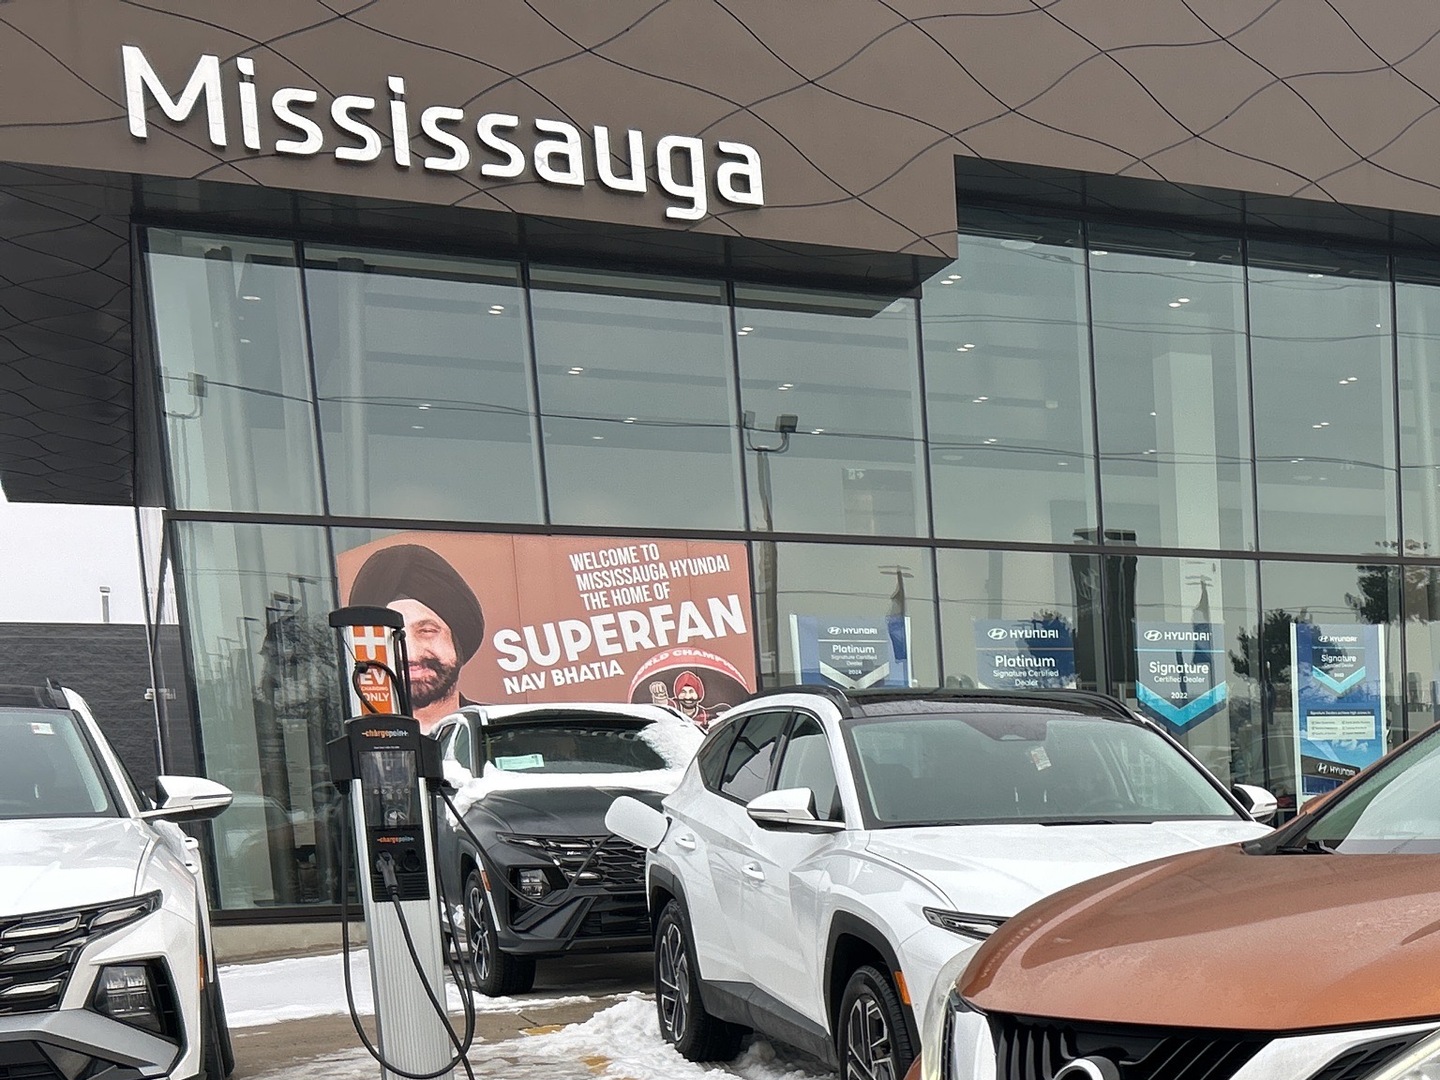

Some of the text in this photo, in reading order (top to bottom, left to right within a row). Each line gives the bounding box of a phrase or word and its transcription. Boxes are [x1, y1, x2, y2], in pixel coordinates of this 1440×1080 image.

[121, 44, 764, 221] Mississauga
[569, 543, 660, 572] WELCOME TO
[575, 554, 731, 591] MISSISSAUGA HYUNDAI
[580, 581, 671, 611] THE HOME OF
[493, 594, 748, 672] SUPERFAN
[843, 627, 878, 635] HYUNDAI
[1009, 629, 1059, 639] HYUNDAI
[1164, 631, 1210, 641] HYUNDAI
[832, 644, 875, 653] Platinum
[995, 654, 1056, 667] Platinum
[1321, 654, 1357, 663] Signature
[993, 669, 1059, 678] Signature Certified
[1149, 661, 1209, 675] Signature
[360, 668, 387, 685] EV
[503, 659, 625, 695] NAV BHATIA
[1154, 675, 1206, 683] Certified Dealer
[1015, 678, 1039, 687] Dealer
[363, 692, 389, 702] ONLY
